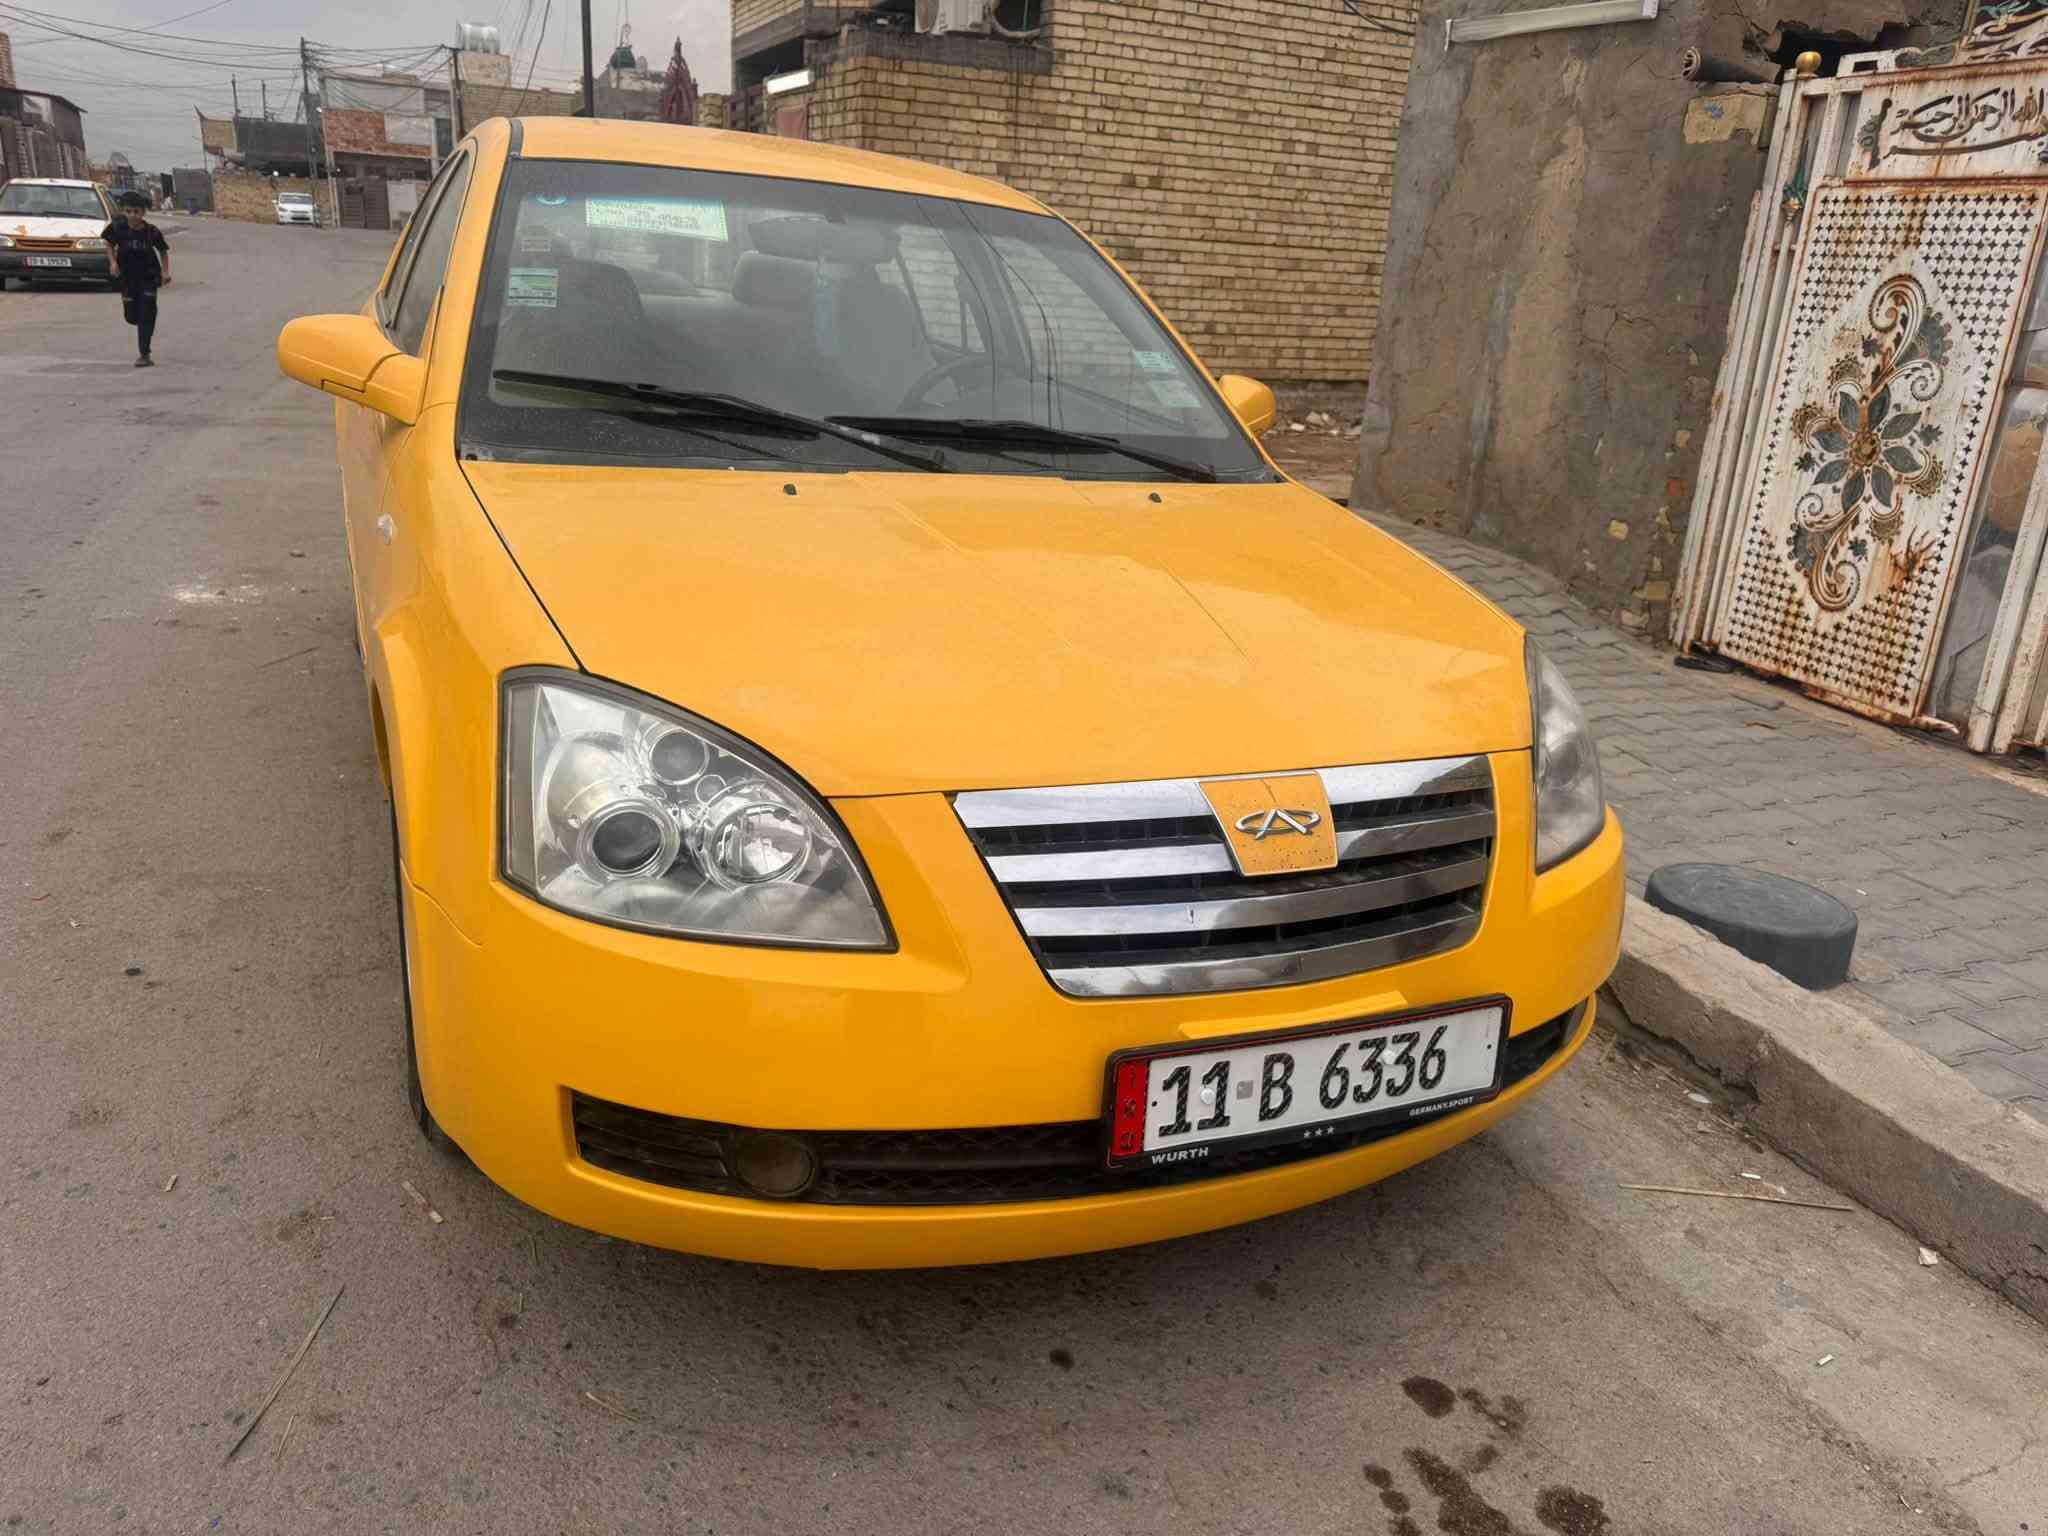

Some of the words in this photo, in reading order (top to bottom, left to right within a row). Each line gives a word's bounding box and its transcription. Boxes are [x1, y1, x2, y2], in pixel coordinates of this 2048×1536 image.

[1158, 1060, 1231, 1137] 11
[1258, 1051, 1296, 1122] B
[1319, 1024, 1449, 1110] 6336
[1151, 1147, 1209, 1165] WURTH
